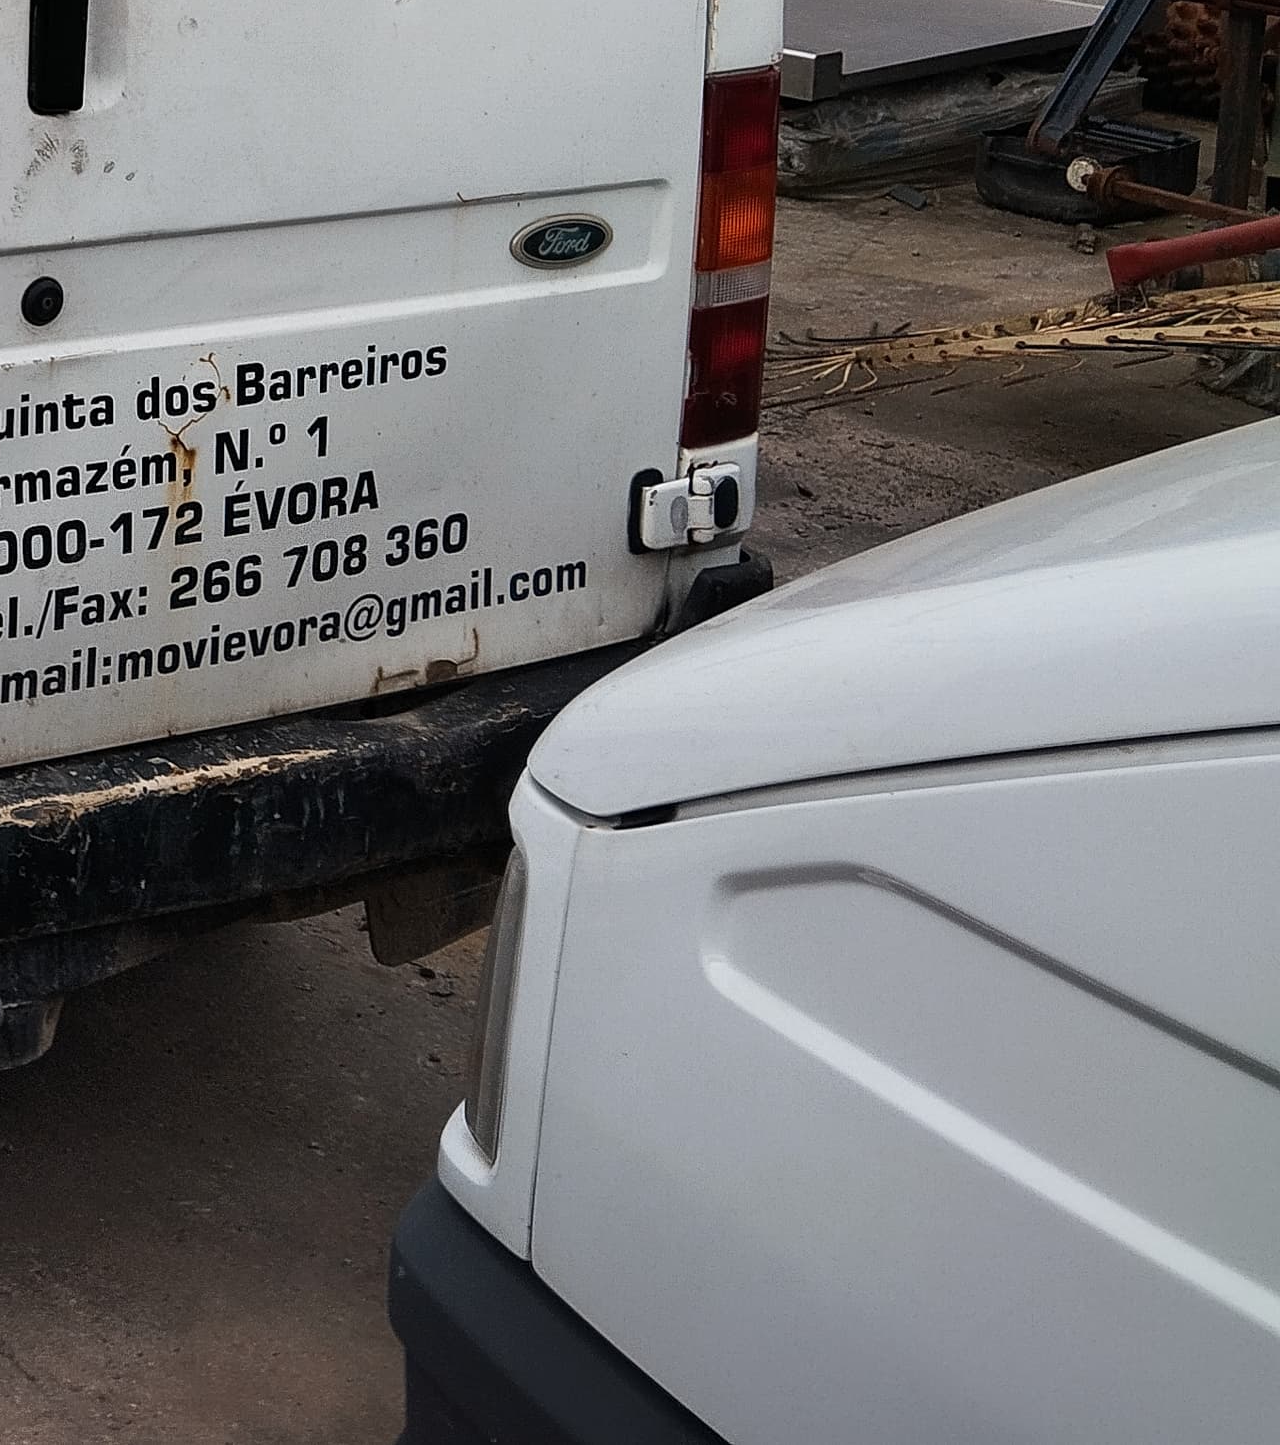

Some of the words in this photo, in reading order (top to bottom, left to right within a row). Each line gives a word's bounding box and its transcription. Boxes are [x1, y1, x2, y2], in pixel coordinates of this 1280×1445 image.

[538, 227, 592, 256] Ford
[136, 376, 218, 421] dos
[236, 344, 447, 407] Barreiros
[307, 415, 329, 458] 1
[223, 470, 379, 538] ÉVORA
[169, 555, 262, 610] 266
[282, 533, 367, 590] 708
[386, 511, 468, 567] 360
